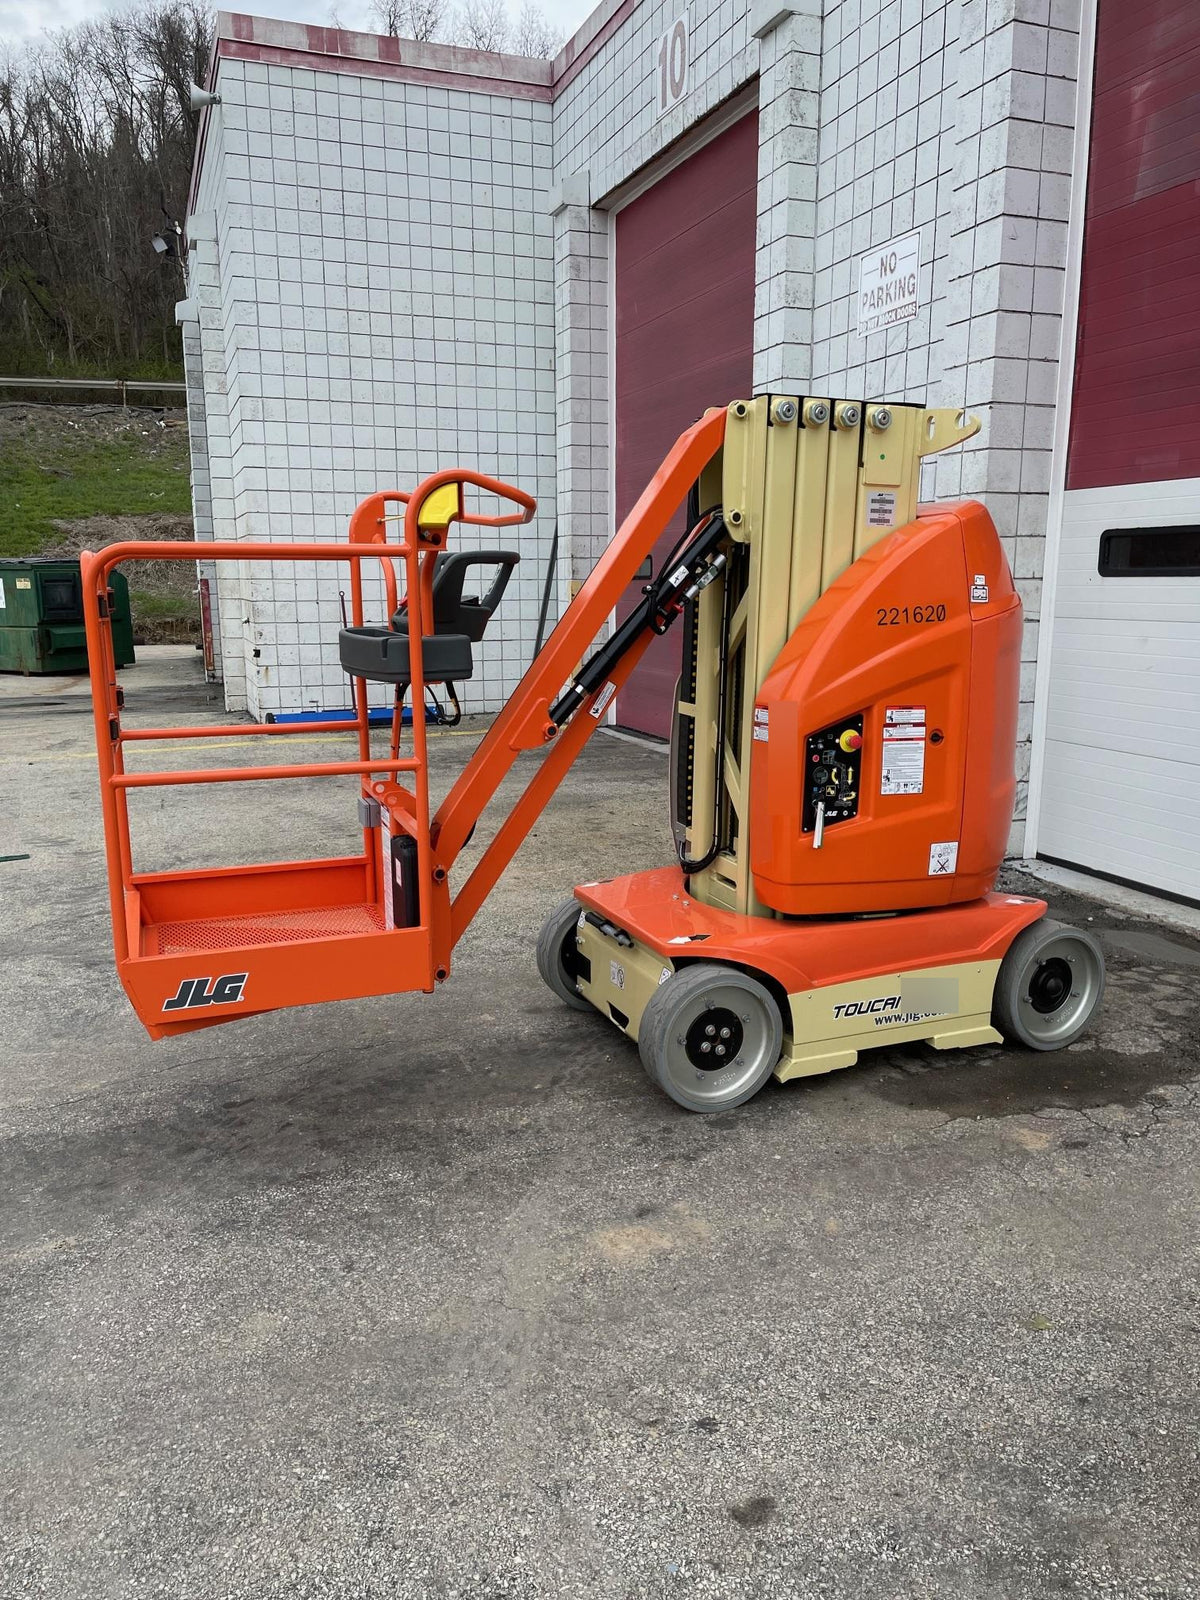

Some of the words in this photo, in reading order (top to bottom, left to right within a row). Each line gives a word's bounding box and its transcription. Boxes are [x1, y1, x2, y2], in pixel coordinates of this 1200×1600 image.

[658, 20, 686, 110] 10
[880, 252, 897, 278] NO
[862, 273, 916, 313] PARKING
[877, 604, 946, 626] 221620
[162, 973, 249, 1011] JLG
[875, 1012, 945, 1026] www.jlg.
